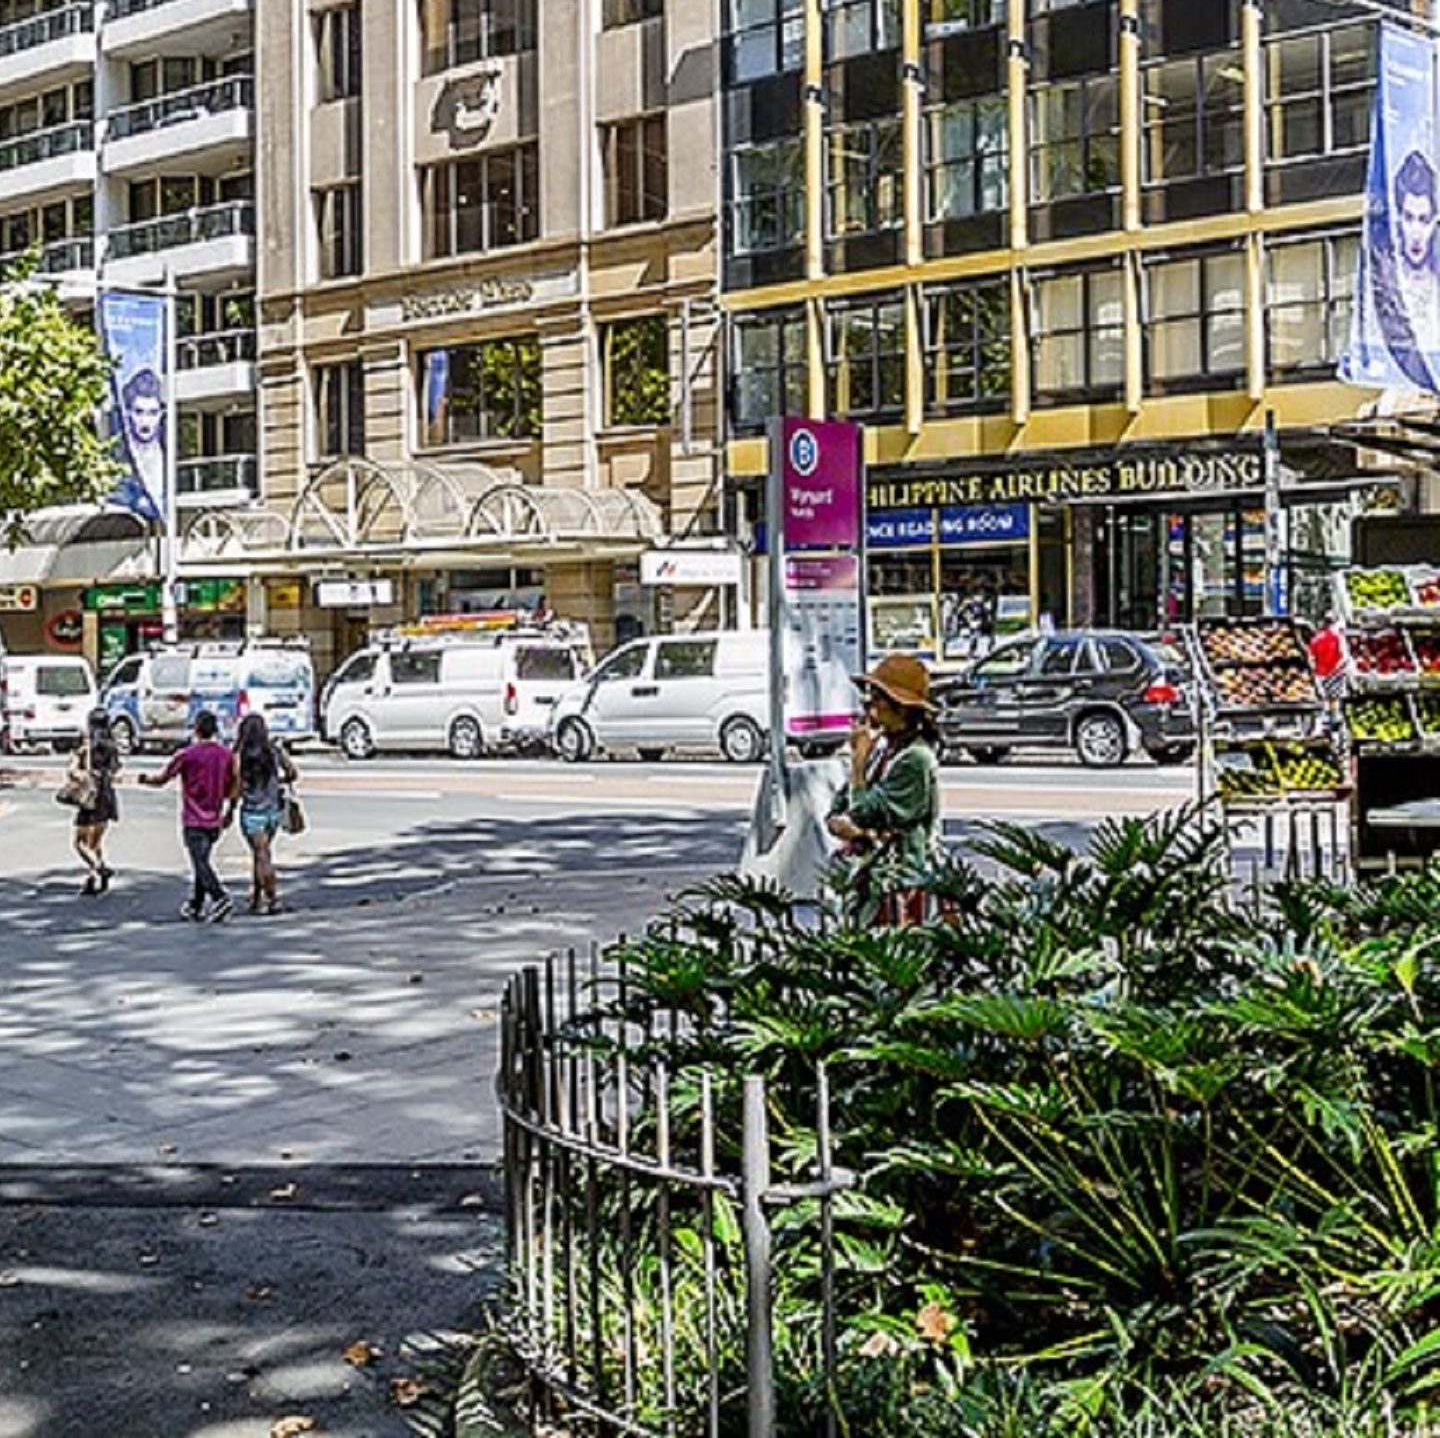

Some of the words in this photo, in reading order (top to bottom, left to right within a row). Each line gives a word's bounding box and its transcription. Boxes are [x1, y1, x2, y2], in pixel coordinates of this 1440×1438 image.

[867, 475, 983, 507] HILIPPINE
[990, 466, 1111, 501] AIRLINES
[1118, 454, 1260, 491] BUILDING
